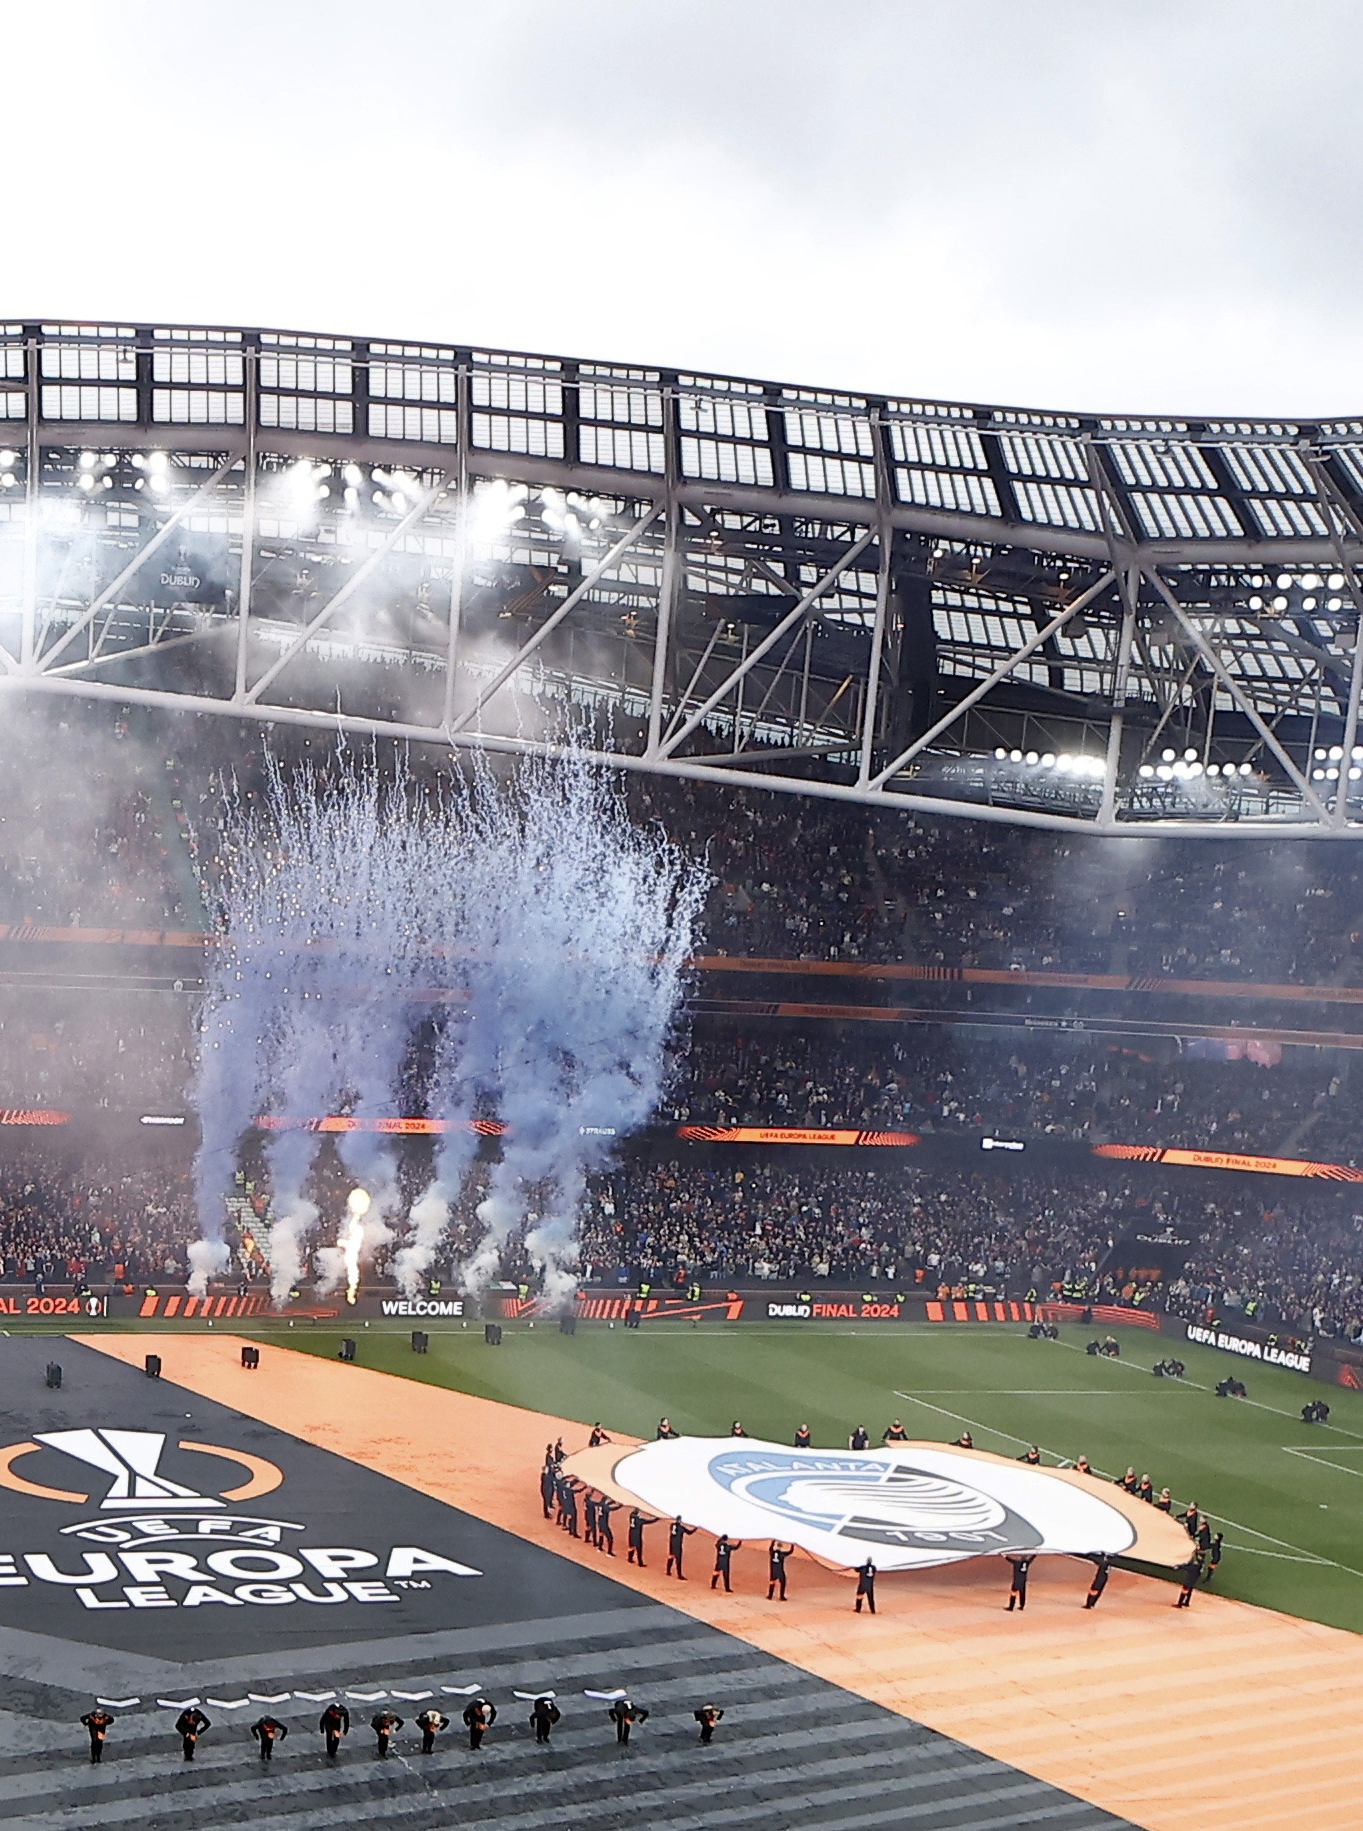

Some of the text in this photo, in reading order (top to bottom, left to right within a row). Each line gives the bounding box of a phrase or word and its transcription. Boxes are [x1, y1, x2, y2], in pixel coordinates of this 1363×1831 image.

[160, 573, 200, 588] DUBLIN
[780, 1132, 807, 1140] EUROPA
[809, 1133, 835, 1141] LEAGUE
[1193, 1154, 1277, 1169] DUBLIN FINAL 2024
[26, 1297, 80, 1314] 2024
[381, 1301, 464, 1316] WELCOME
[768, 1303, 900, 1318] DUBLIN FINAL 2024
[1187, 1325, 1312, 1372] UEFA EUROPA LEAGUE
[716, 1459, 889, 1477] ATALANTA
[76, 1518, 282, 1544] UEFA
[719, 1544, 727, 1555] 1
[772, 1552, 780, 1563] 1
[866, 1566, 874, 1577] 1
[72, 1580, 401, 1610] LEAGUE
